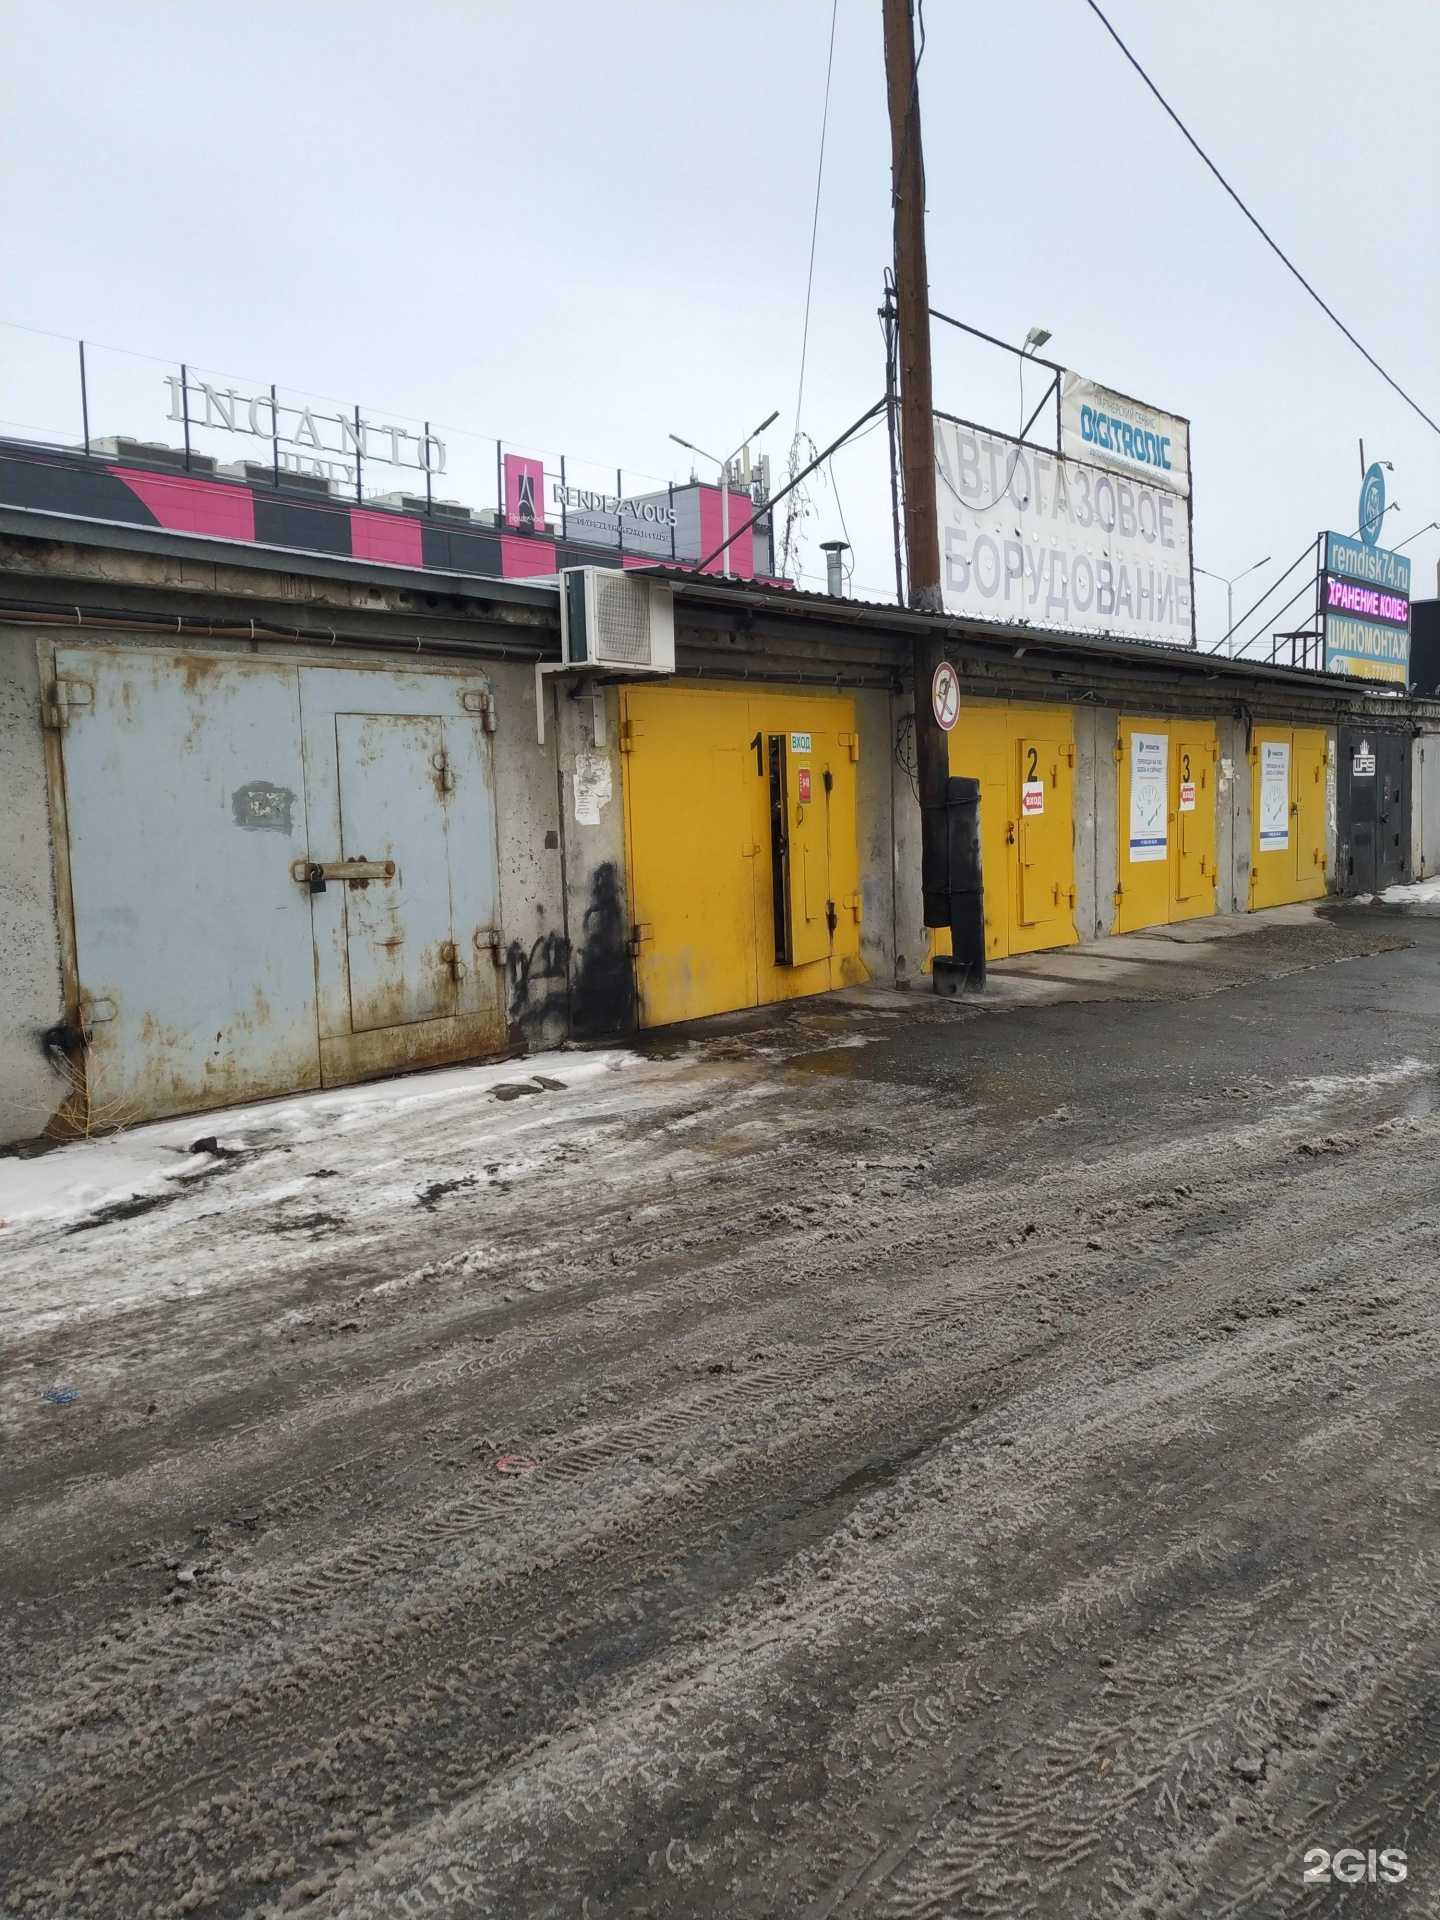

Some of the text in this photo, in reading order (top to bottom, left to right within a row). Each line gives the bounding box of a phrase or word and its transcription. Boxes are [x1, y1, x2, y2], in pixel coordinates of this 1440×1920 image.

[163, 375, 447, 475] INCANTO
[1080, 404, 1172, 471] DIGITRONIC
[944, 526, 1192, 626] БОРУДОВАНИЕ
[1332, 544, 1408, 588] remdisk74.ru
[1328, 581, 1408, 622] ХРАНЕНИЕ КОЛЕС
[1328, 618, 1408, 660] ШИНОМОНТАЖ
[750, 732, 764, 776] 1
[792, 735, 811, 749] ВХОД
[1027, 748, 1038, 782] 2
[1182, 754, 1191, 783] 3
